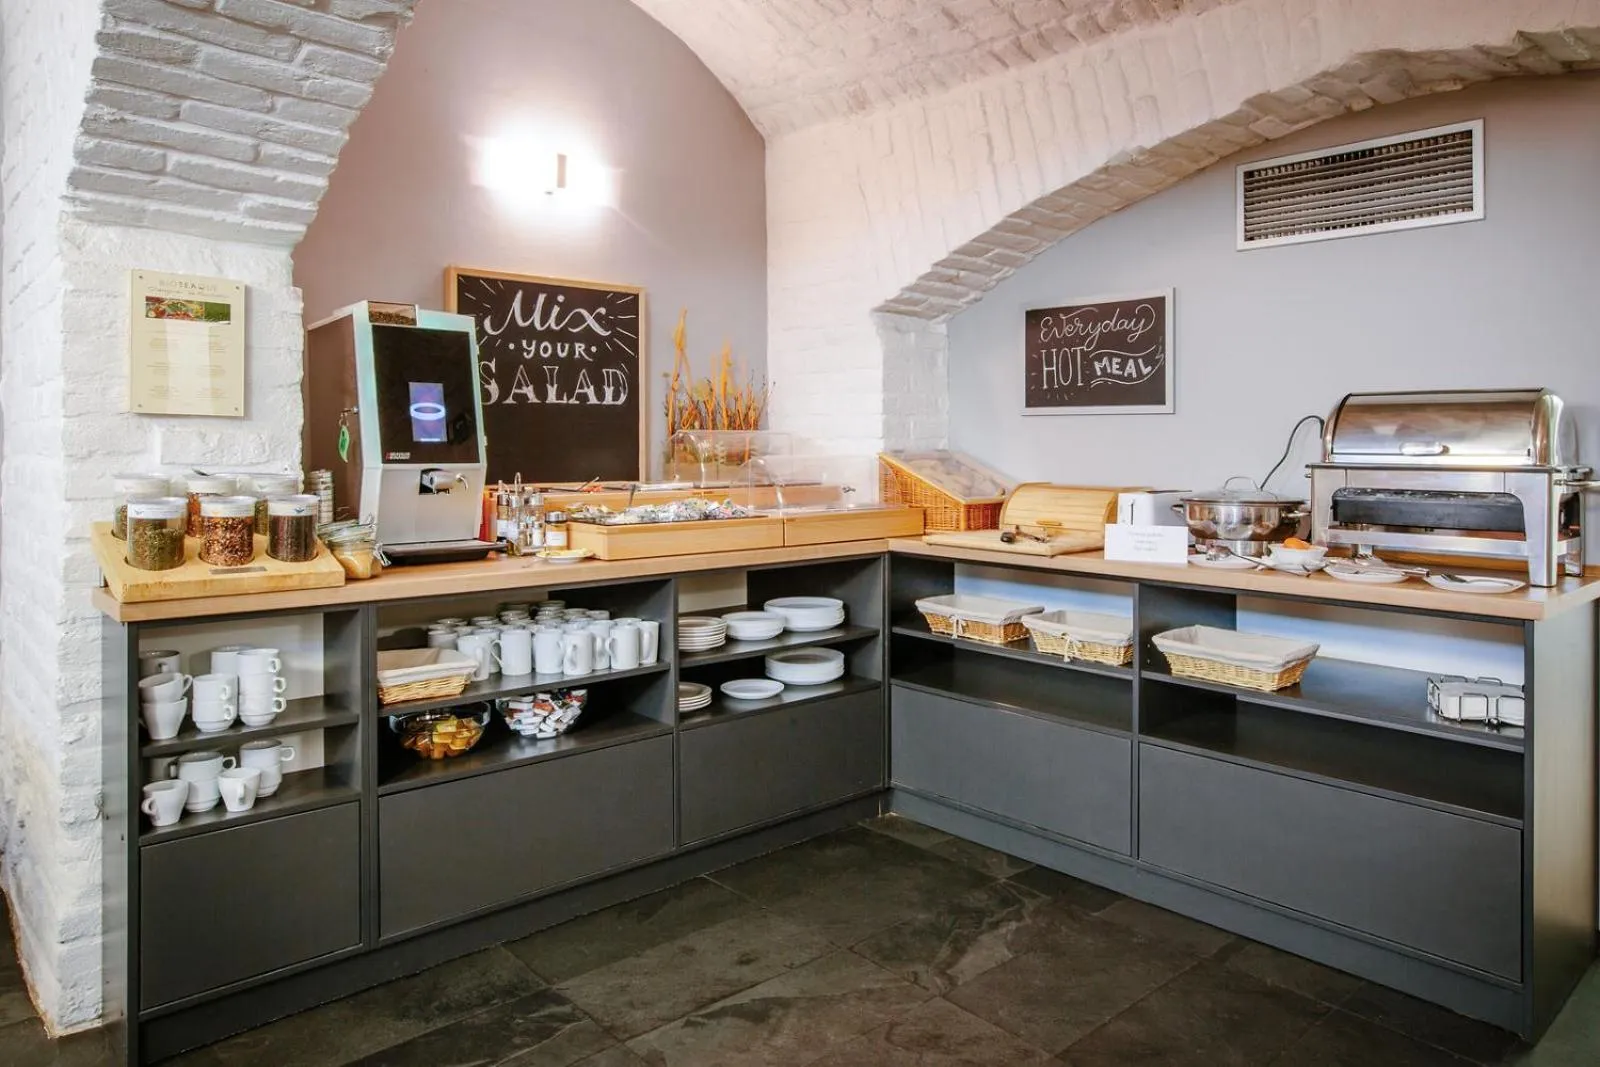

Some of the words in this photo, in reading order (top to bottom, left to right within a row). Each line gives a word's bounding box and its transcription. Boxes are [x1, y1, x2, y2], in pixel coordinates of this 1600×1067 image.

[483, 289, 612, 336] Mix
[1040, 303, 1156, 351] Everyday
[521, 339, 593, 362] YOUR
[1040, 345, 1086, 389] HOT
[1094, 356, 1152, 379] MEAL
[479, 357, 629, 406] SALAD
